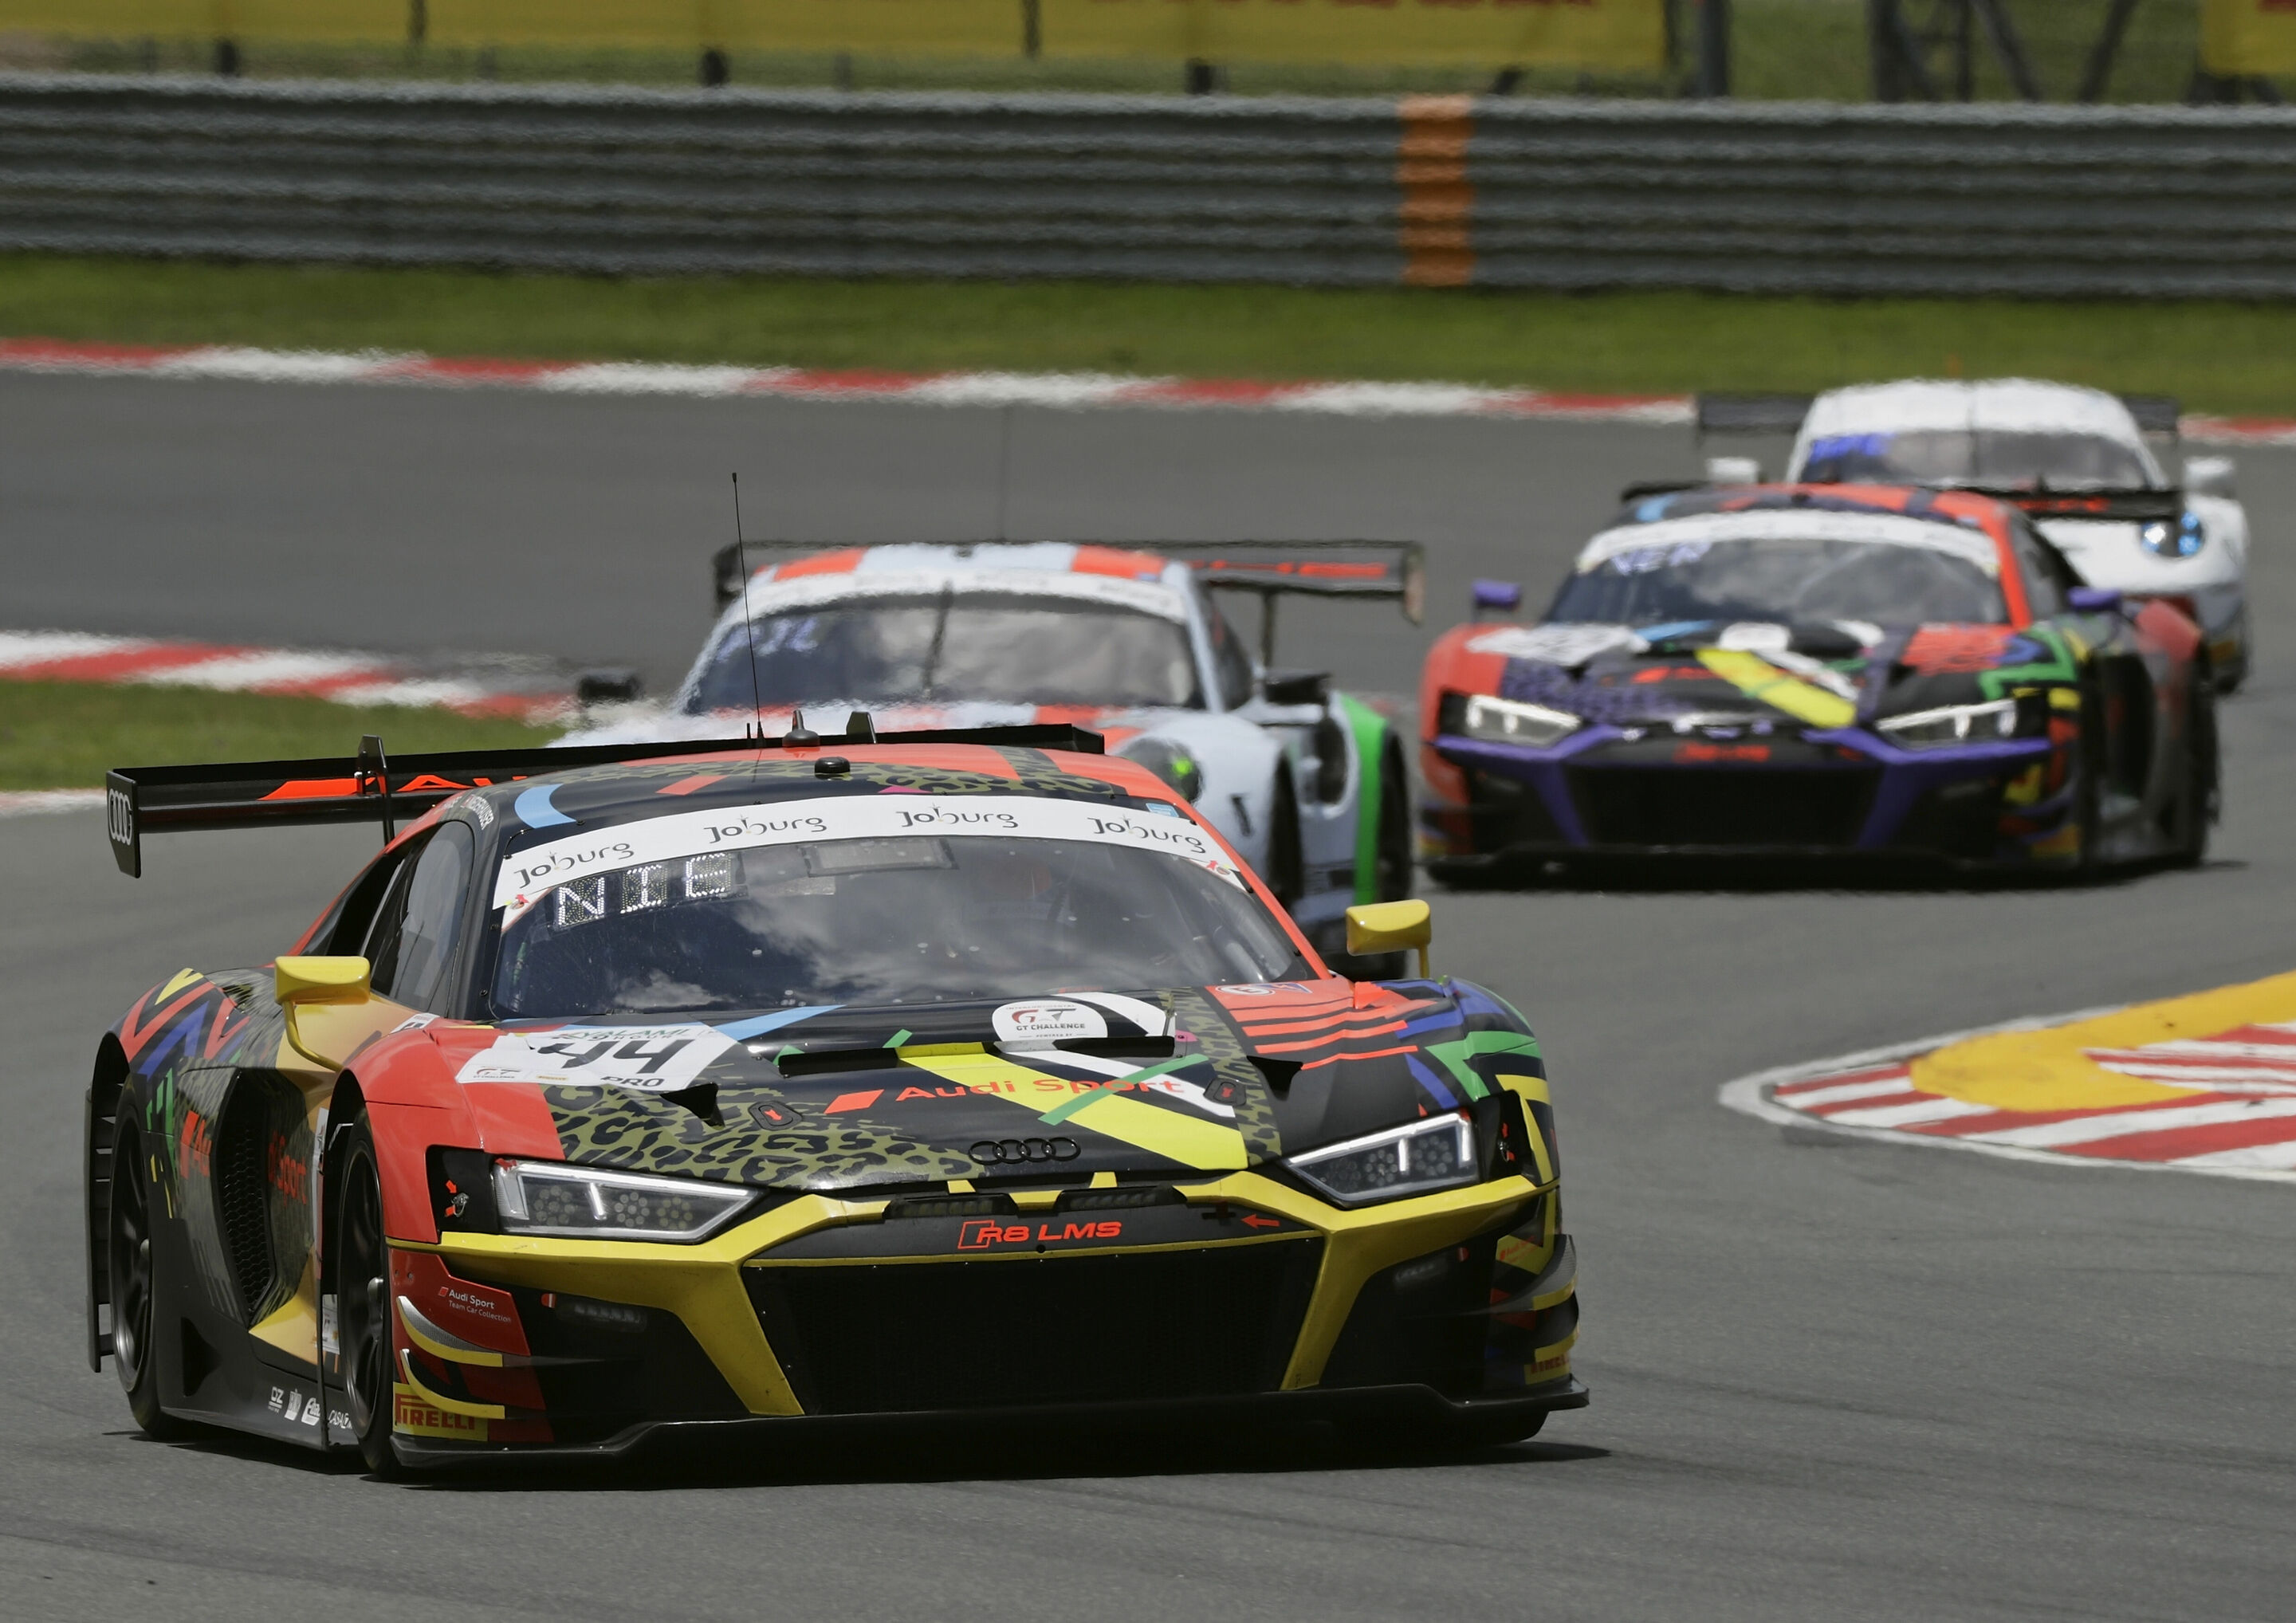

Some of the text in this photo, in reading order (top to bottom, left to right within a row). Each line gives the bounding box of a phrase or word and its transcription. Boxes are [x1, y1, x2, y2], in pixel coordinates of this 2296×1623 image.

[704, 815, 827, 843] Joburg
[896, 804, 1018, 828] Joburg
[1087, 814, 1206, 854] Joburg
[513, 842, 635, 888] Joburg
[558, 851, 731, 926] NIE
[537, 1039, 694, 1074] 44
[600, 1076, 664, 1087] PRO
[895, 1079, 1185, 1102] Audi Sport
[277, 1154, 307, 1207] Sport
[975, 1221, 1122, 1244] R8 LMS
[449, 1290, 494, 1309] Audi Sport
[449, 1300, 466, 1311] Team
[478, 1310, 512, 1322] Collection
[395, 1393, 475, 1430] PIRELLI
